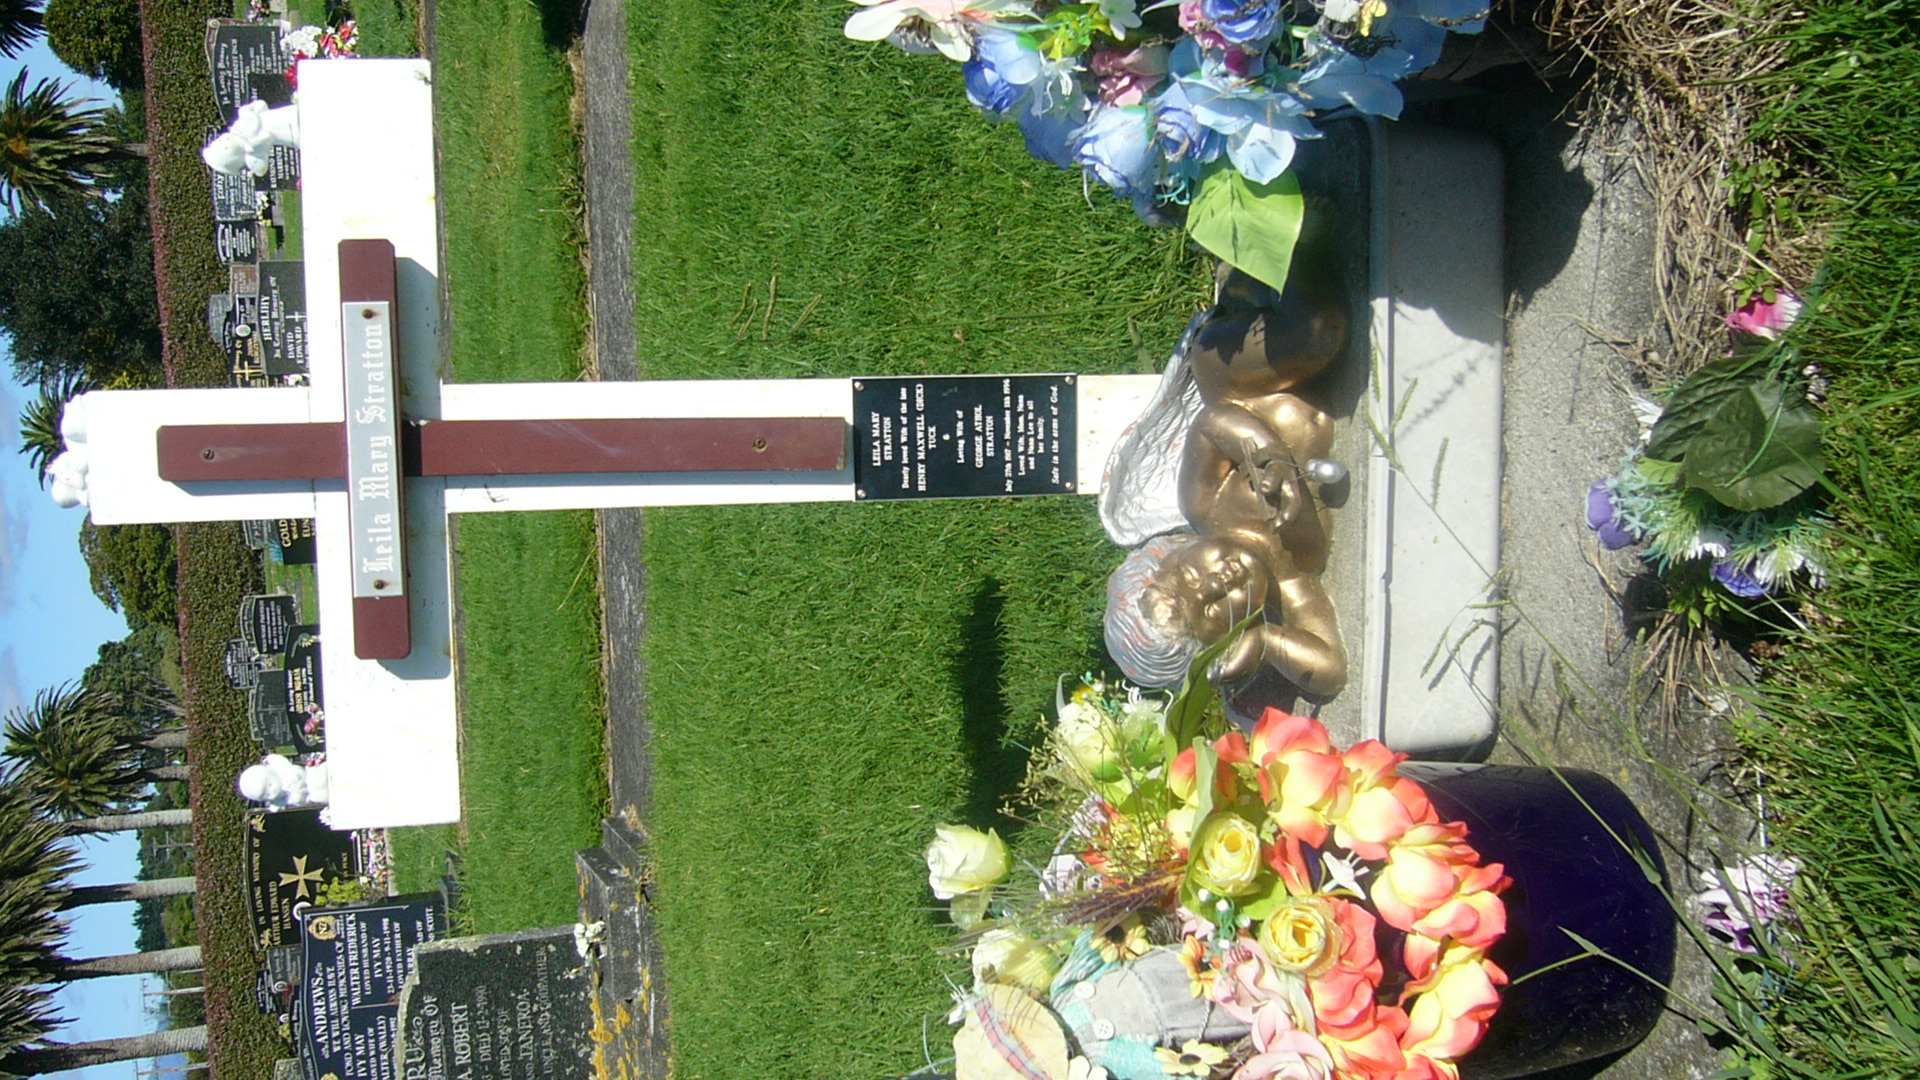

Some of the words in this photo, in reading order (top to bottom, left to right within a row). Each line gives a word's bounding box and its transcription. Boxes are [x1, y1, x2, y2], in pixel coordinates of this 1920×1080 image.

[271, 289, 279, 319] Memory
[260, 295, 272, 340] HERLIHY
[272, 321, 280, 347] Loving
[286, 332, 295, 359] DAVID
[295, 326, 304, 364] EDWARD
[354, 324, 388, 424] Stratton
[900, 403, 908, 414] the
[916, 384, 924, 411] (DICK)
[1026, 400, 1034, 410] all
[1050, 406, 1058, 415] of
[871, 411, 880, 437] MARY
[900, 416, 908, 425] of
[956, 410, 964, 419] of
[974, 404, 983, 432] ATHOL
[883, 417, 892, 460] STRATTON
[900, 427, 908, 443] Wife
[916, 414, 925, 460] MAXWELL
[928, 426, 937, 449] TUCK
[956, 421, 964, 437] Wife
[986, 416, 994, 457] STRATTON
[872, 440, 881, 466] LEILA
[901, 446, 909, 464] loved
[957, 439, 966, 463] Loving
[975, 435, 984, 468] GEORGE
[1051, 440, 1059, 453] the
[1052, 455, 1059, 464] in
[357, 436, 393, 500] Mary
[901, 466, 910, 489] Dearly
[917, 462, 926, 491] HENRY
[1018, 455, 1026, 475] Loved
[1051, 467, 1060, 484] Safe
[1005, 480, 1013, 492] July
[362, 513, 394, 573] Leila
[252, 838, 260, 848] OF
[252, 852, 261, 882] MEMORY
[254, 886, 264, 912] LOVING
[269, 880, 279, 913] EDWARD
[282, 898, 292, 930] HANSEN
[360, 921, 368, 932] OF
[394, 921, 401, 932] OF
[416, 920, 424, 931] OF
[270, 915, 282, 946] ARTHUR
[345, 913, 359, 966] FREDERICK
[335, 940, 344, 953] OF
[361, 933, 370, 968] HUSBAND
[371, 936, 381, 958] MAY
[394, 933, 403, 961] FATHER
[372, 960, 383, 978] IVY
[406, 947, 415, 976] URRAY
[336, 955, 348, 998] MEMORIES
[350, 967, 362, 1005] WALTER
[362, 969, 372, 995] LOVED
[311, 976, 329, 1044] ANDREWS
[340, 999, 350, 1030] LOVING
[330, 1018, 341, 1038] WILL
[342, 1032, 352, 1050] AND
[367, 1027, 375, 1036] OF
[376, 1015, 388, 1052] (WALLY)
[451, 1002, 472, 1065] ROBERT
[332, 1040, 342, 1053] WE
[354, 1033, 366, 1055] MAY
[368, 1038, 376, 1056] WIFE
[542, 1039, 554, 1073] UNCLE
[344, 1052, 354, 1076] FOND
[356, 1058, 368, 1077] IVY
[380, 1053, 390, 1080] ALTER
